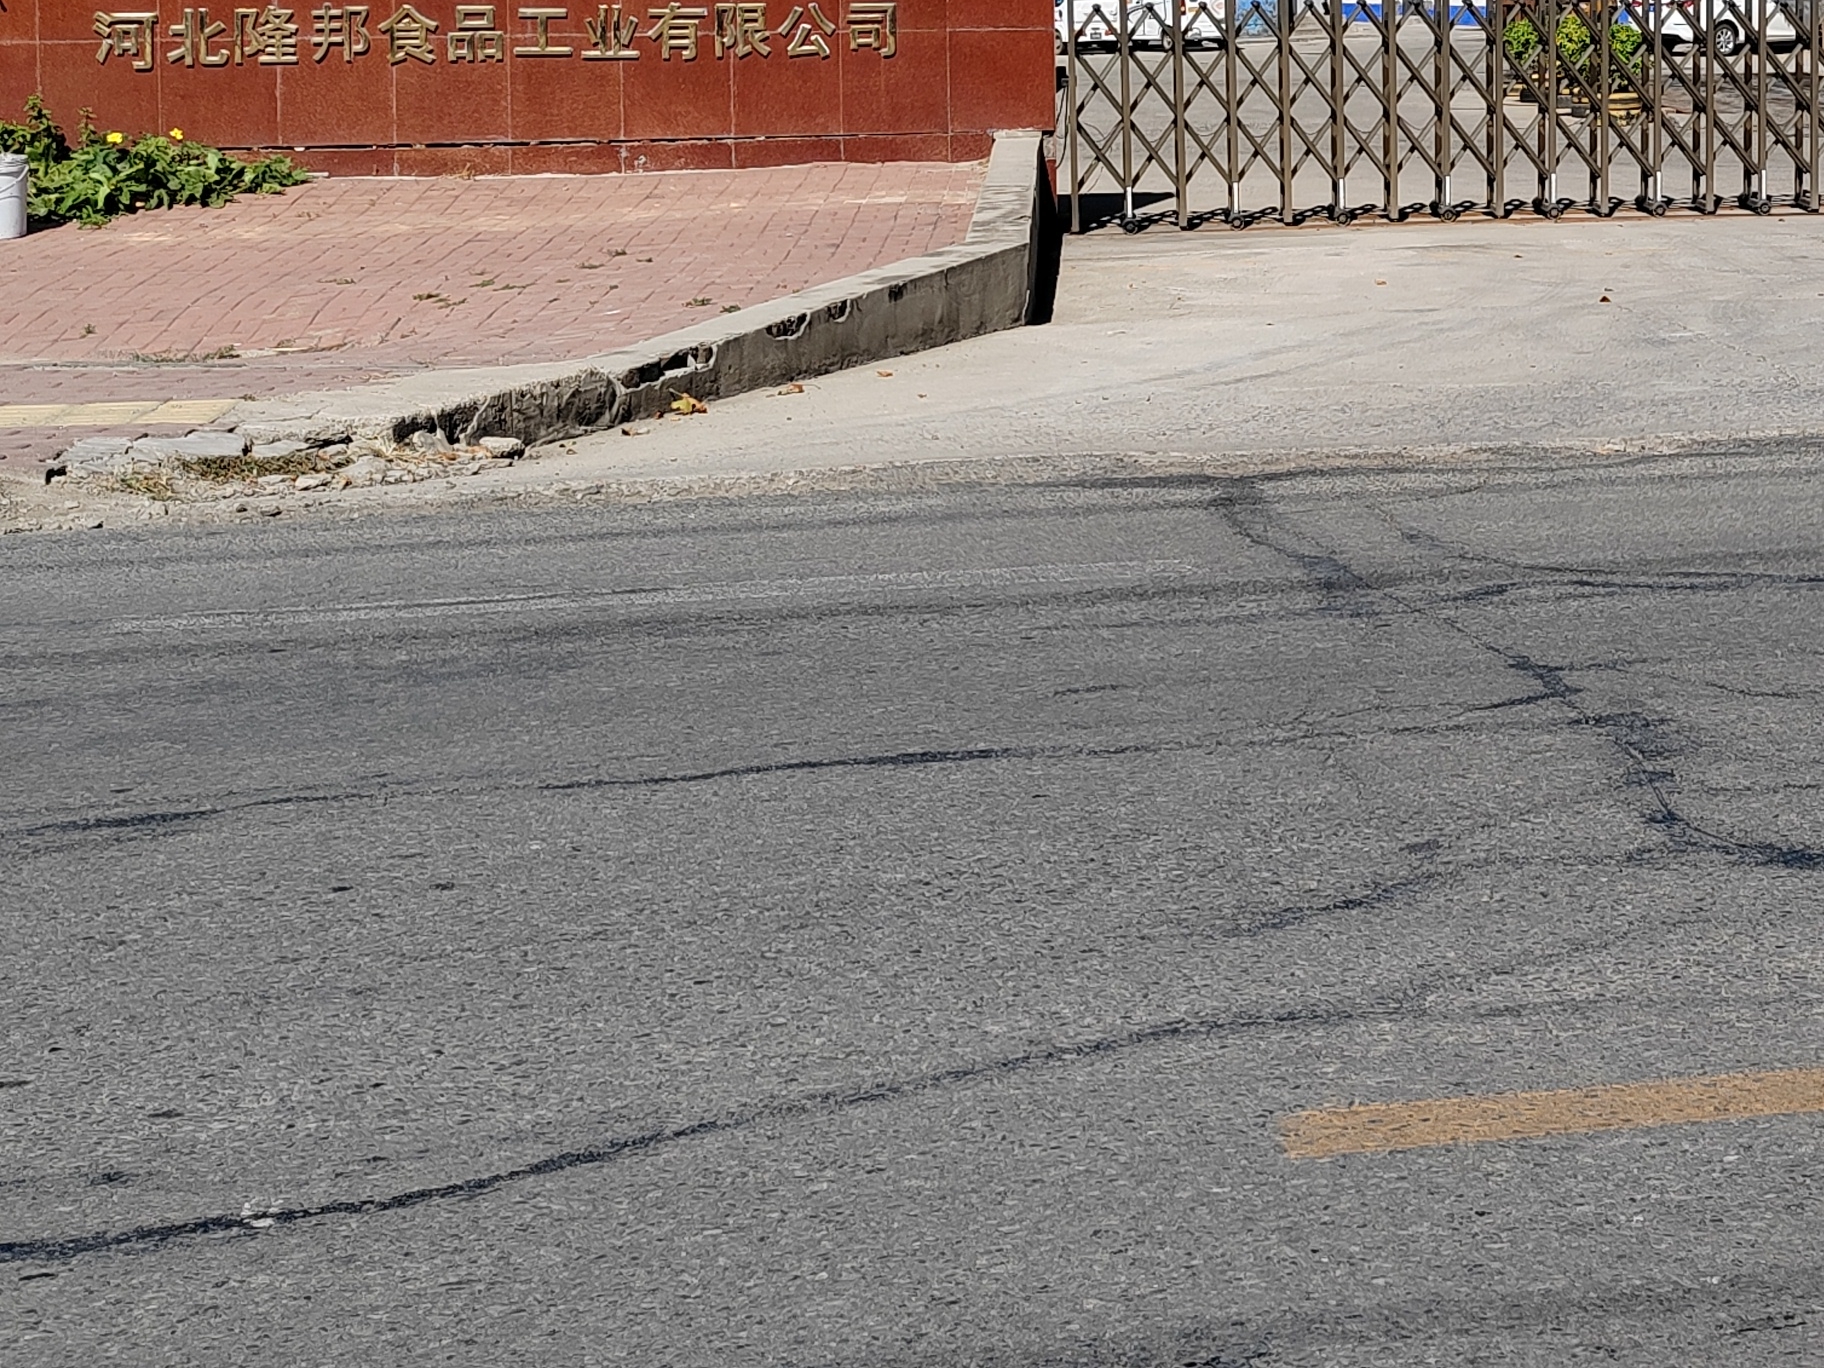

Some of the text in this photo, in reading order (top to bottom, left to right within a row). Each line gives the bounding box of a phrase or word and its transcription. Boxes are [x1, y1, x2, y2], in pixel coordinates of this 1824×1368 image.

[92, 1, 898, 70] 河北隆邦食品工业有限公司
